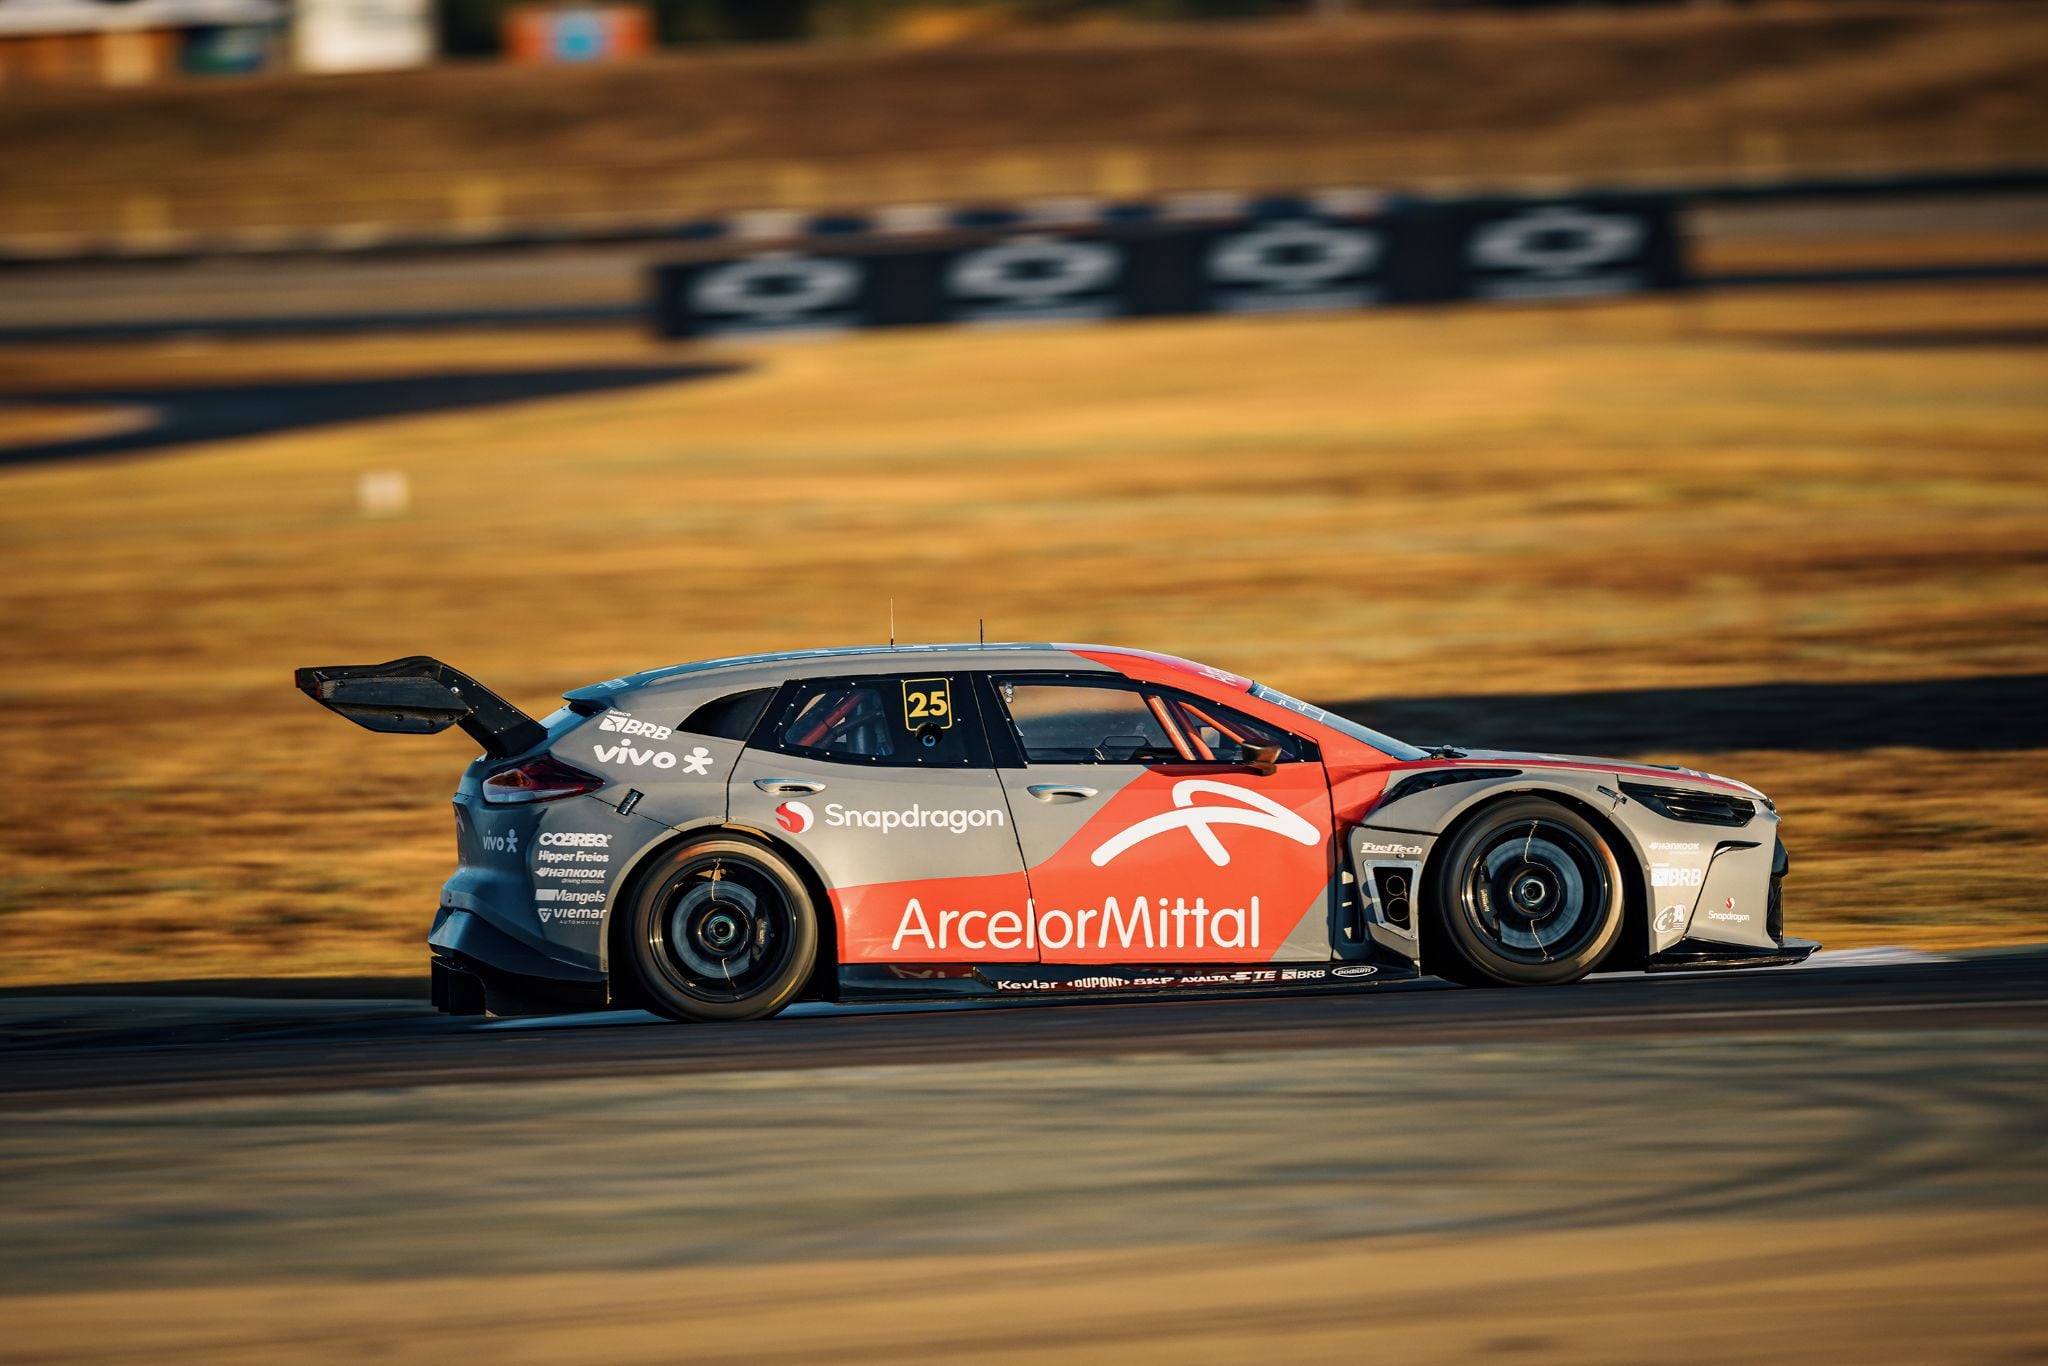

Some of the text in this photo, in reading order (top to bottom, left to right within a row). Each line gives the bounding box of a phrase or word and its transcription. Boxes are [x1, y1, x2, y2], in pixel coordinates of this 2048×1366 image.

[908, 691, 948, 718] 25
[621, 717, 673, 741] BRB
[593, 738, 677, 769] vivo
[825, 803, 1004, 835] Snapdragon
[482, 829, 505, 851] vivo
[1360, 842, 1423, 855] FuelTech
[538, 850, 610, 863] Hipper Freios
[1669, 867, 1702, 887] BRB
[554, 889, 606, 905] Mangels
[891, 896, 1260, 950] ArcelorMittal
[1708, 910, 1750, 923] Snapdragon
[997, 979, 1058, 990] Kevlar
[1133, 976, 1175, 985] SKF
[1180, 975, 1229, 984] AXALTA
[1297, 969, 1326, 979] BRB
